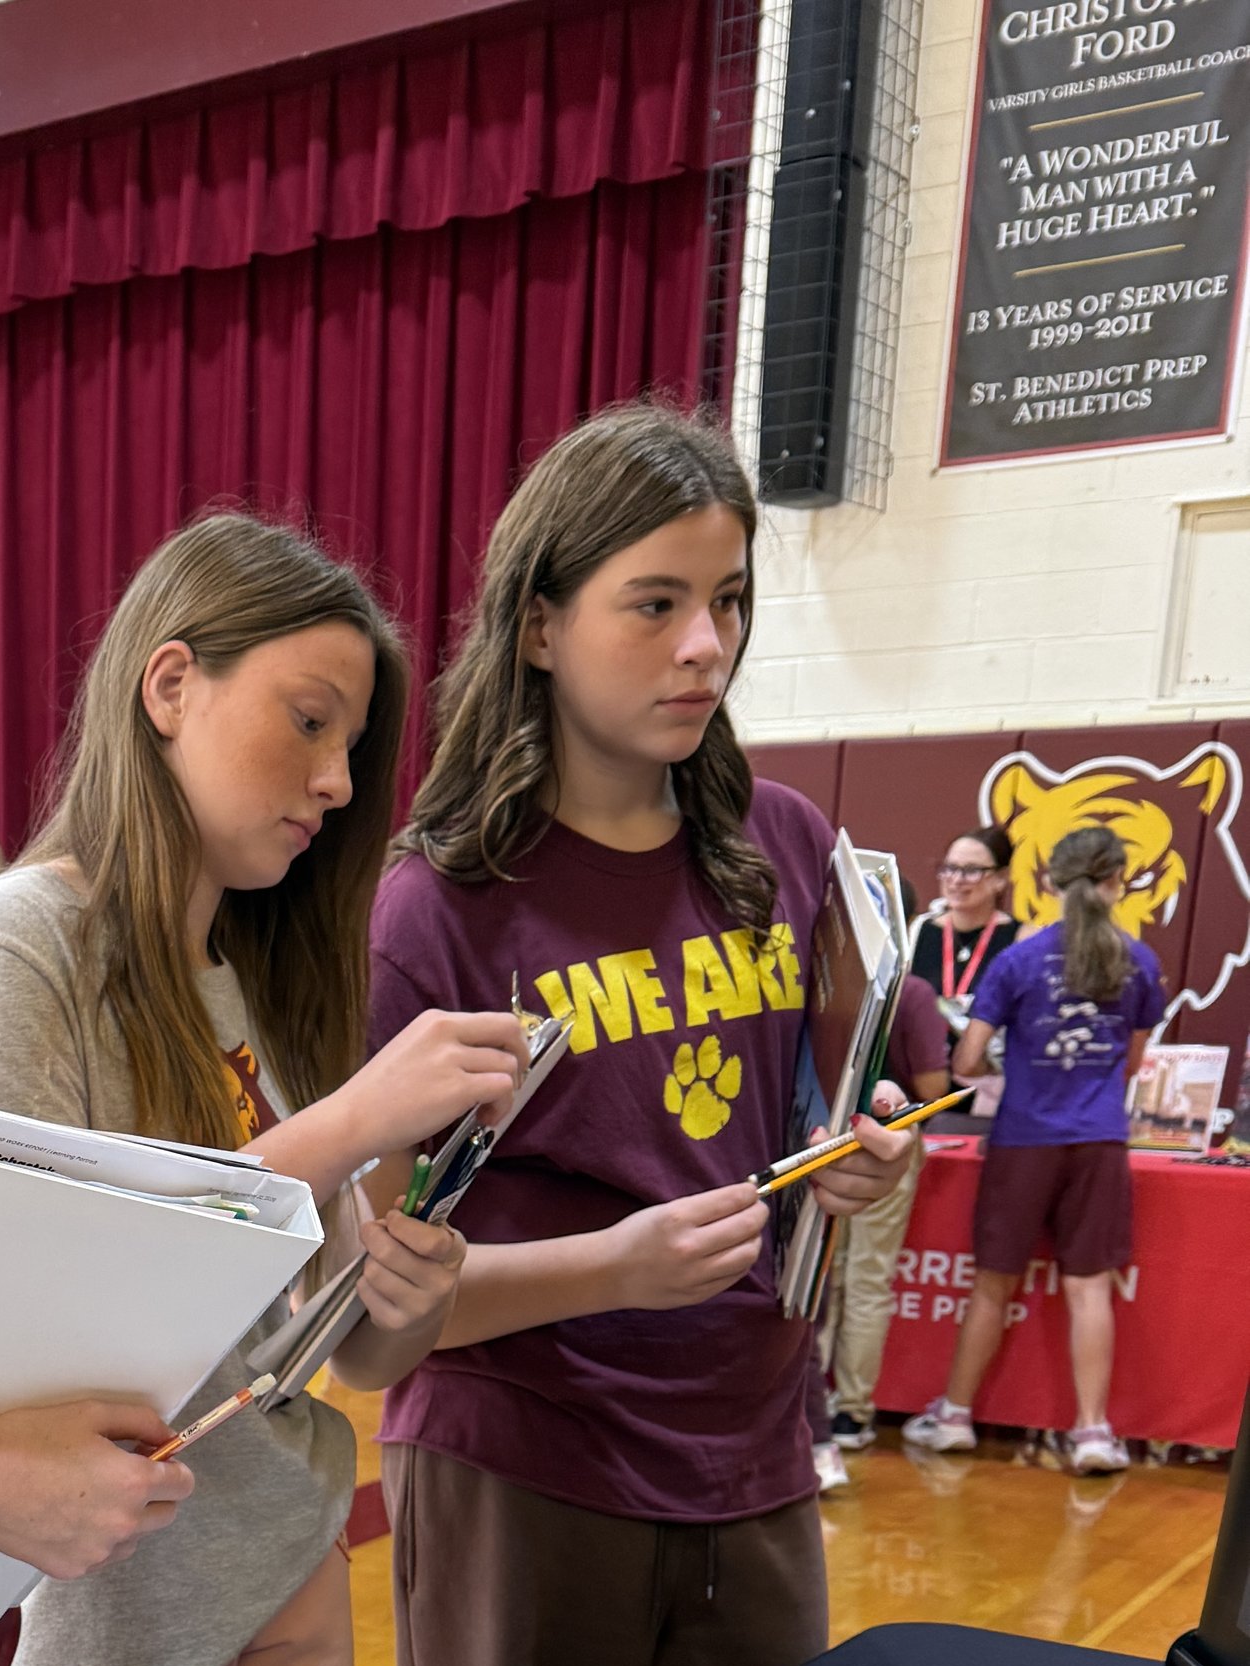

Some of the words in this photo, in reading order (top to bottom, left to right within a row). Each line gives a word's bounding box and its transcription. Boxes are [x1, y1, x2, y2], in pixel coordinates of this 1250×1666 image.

[1070, 19, 1176, 69] FORD
[988, 88, 1050, 111] VARSITY
[1051, 78, 1096, 99] GIRLS
[1099, 59, 1195, 91] BASKETBALL
[999, 154, 1033, 183] "A
[1038, 119, 1229, 176] WONDERFUL
[1018, 179, 1088, 214] MAN
[1094, 165, 1172, 198] WITH
[1173, 159, 1197, 184] A
[996, 213, 1081, 250] HUGE
[1085, 185, 1215, 233] HEART."
[966, 311, 990, 334] 13
[995, 299, 1073, 330] YEARS
[1080, 293, 1113, 317] OF
[1119, 275, 1229, 311] SERVICE
[1028, 312, 1154, 350] 1999-2011
[969, 381, 1006, 406] ST.
[1011, 362, 1140, 399] BENEDICT
[1143, 354, 1208, 379] PREP
[1011, 388, 1153, 426] ATHLETICS
[534, 948, 675, 1055] WE
[681, 922, 805, 1027] ARE
